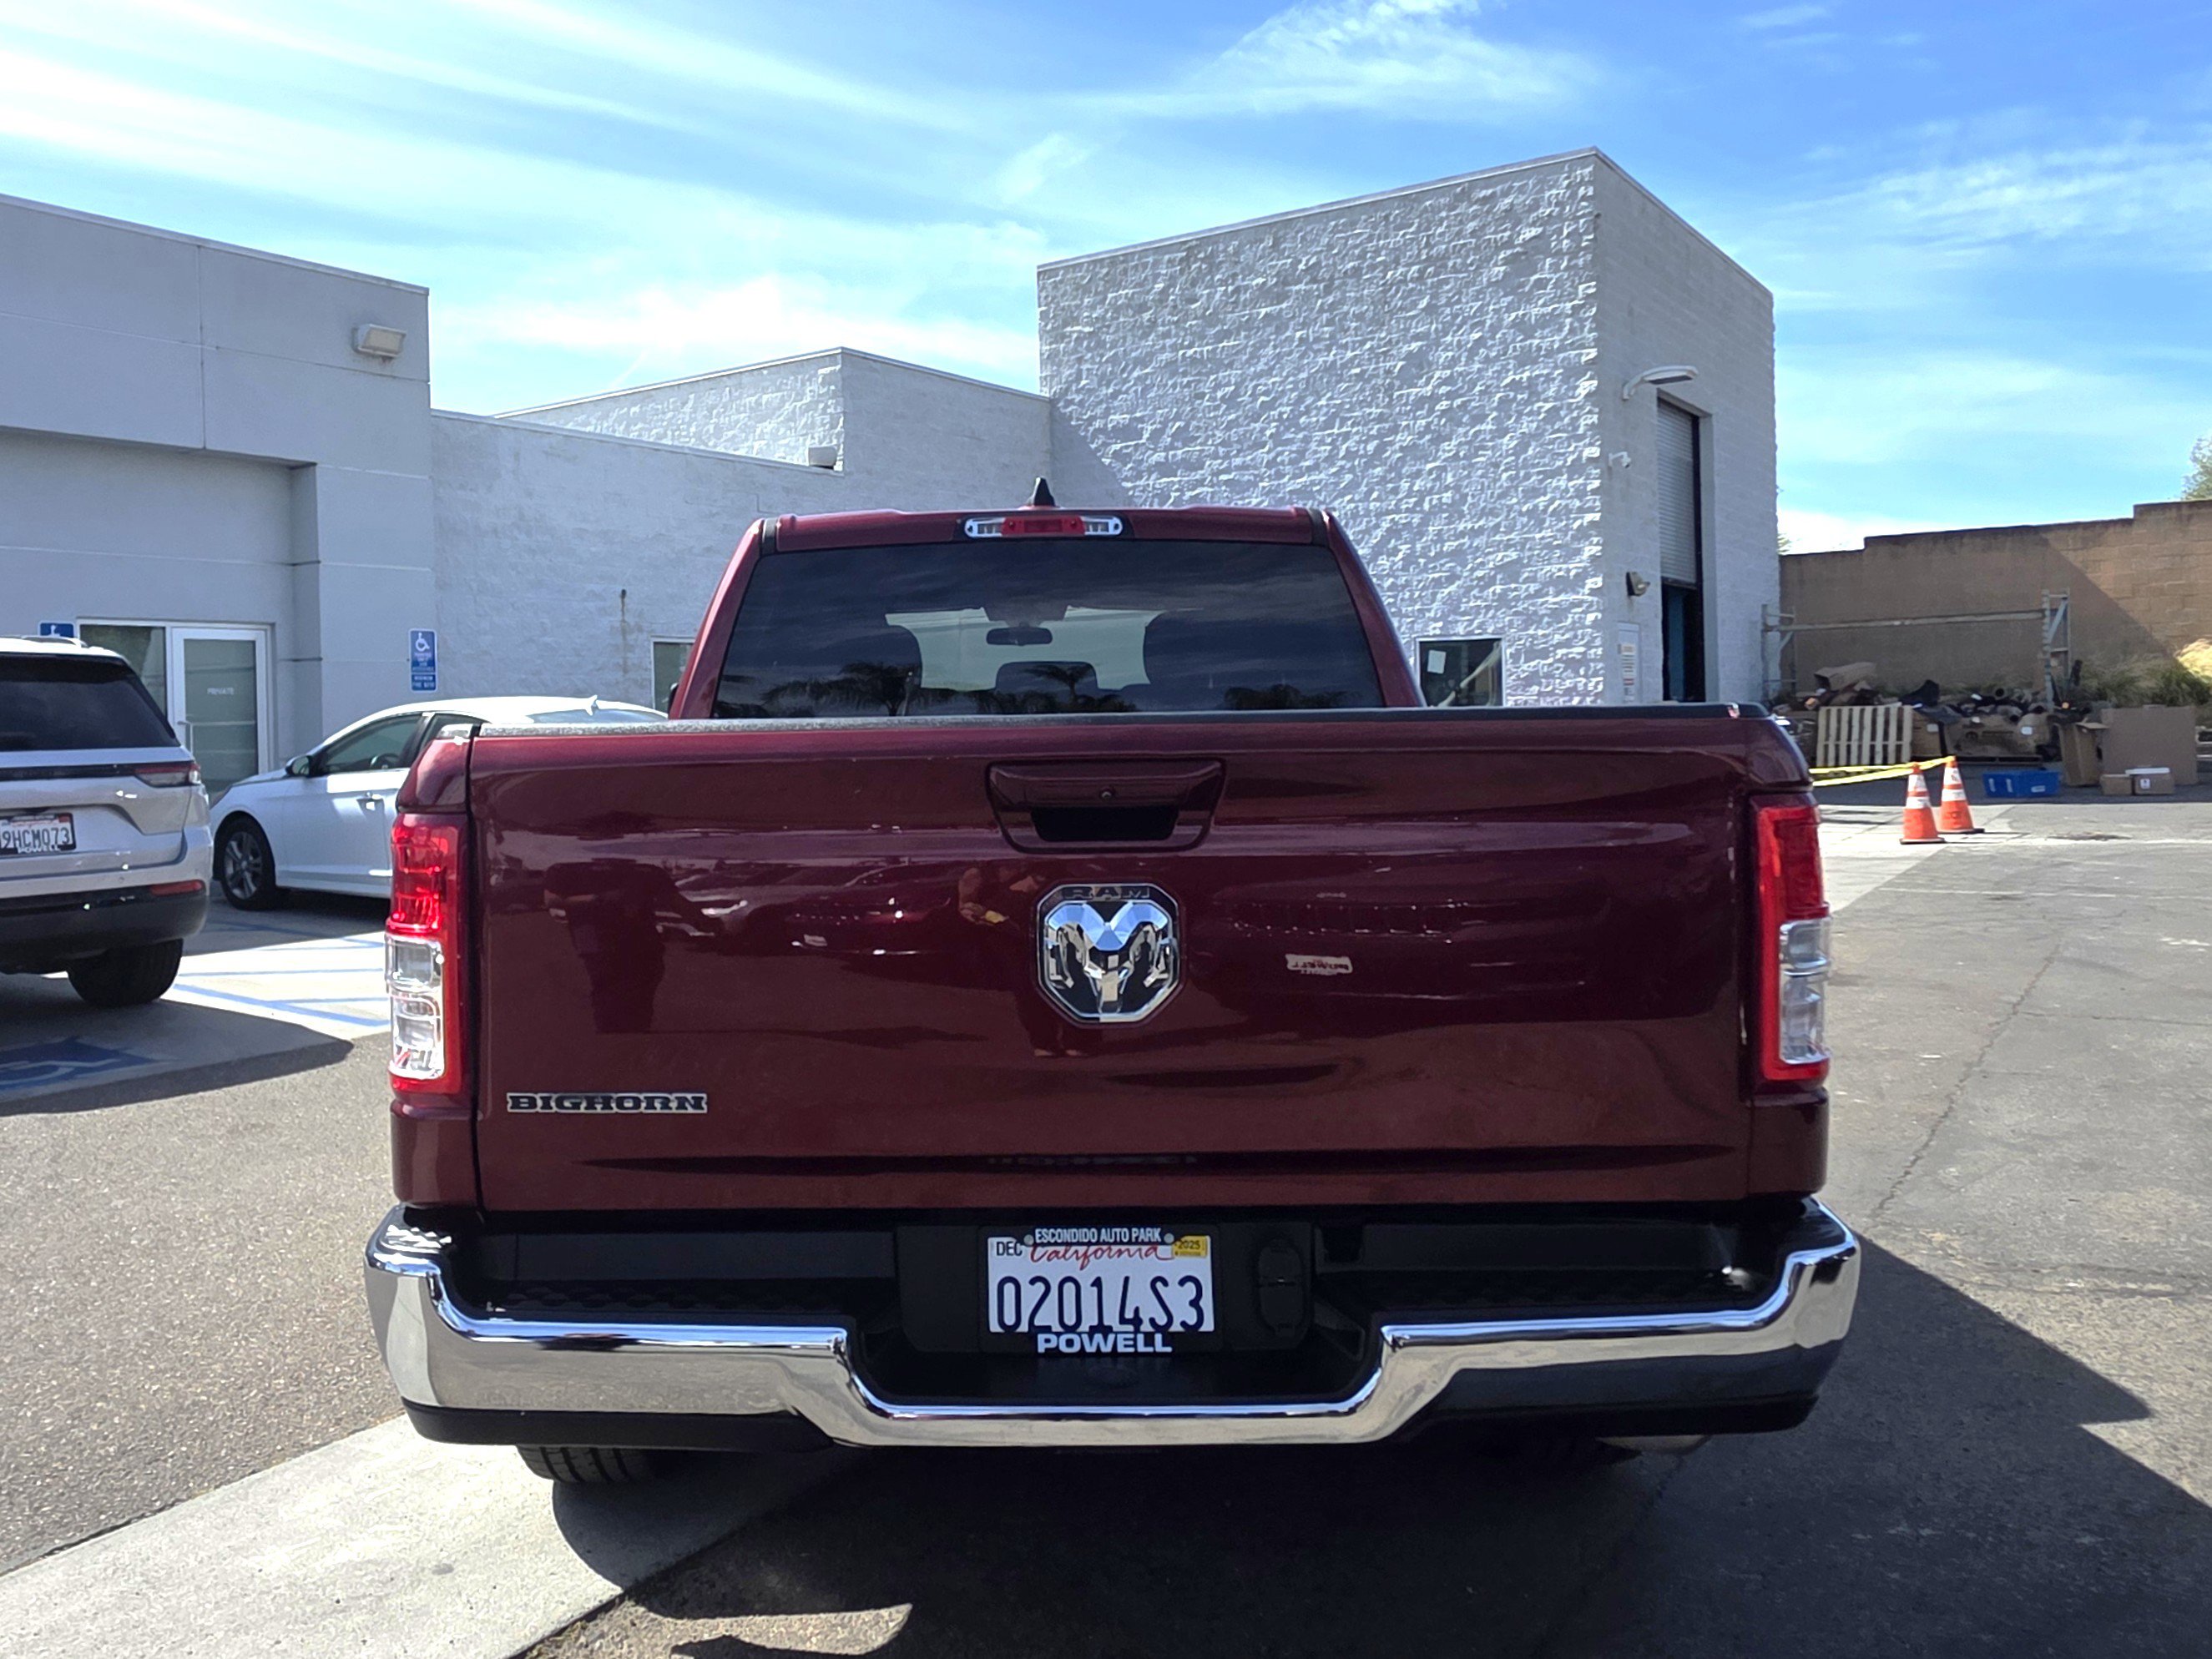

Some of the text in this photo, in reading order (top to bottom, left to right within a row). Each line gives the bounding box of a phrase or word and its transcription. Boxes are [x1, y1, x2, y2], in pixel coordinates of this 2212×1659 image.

[1061, 885, 1150, 900] RAM
[507, 1092, 708, 1113] BIGHORN
[1035, 1228, 1161, 1243] ESCONDIDO AUTO PARK
[1177, 1239, 1200, 1250] 2025
[996, 1241, 1023, 1257] DEC
[1030, 1244, 1174, 1271] California
[997, 1275, 1204, 1333] 02014S3
[1037, 1333, 1173, 1354] POWELL
